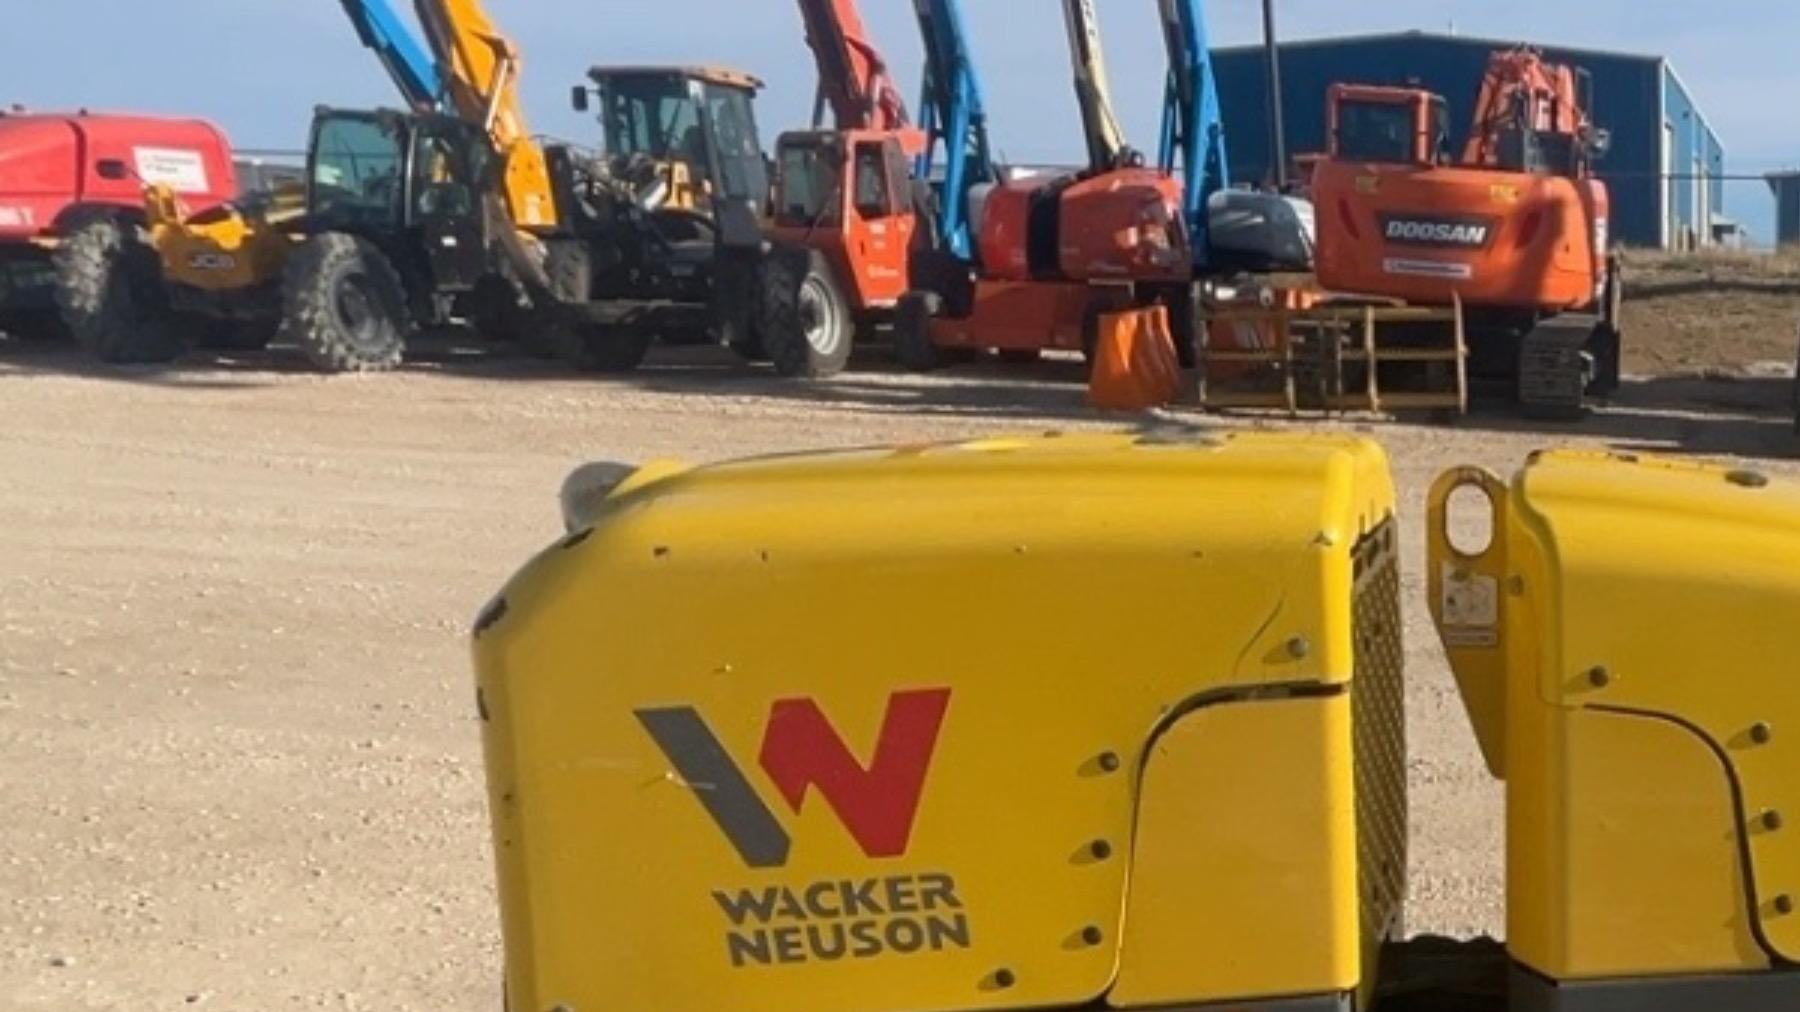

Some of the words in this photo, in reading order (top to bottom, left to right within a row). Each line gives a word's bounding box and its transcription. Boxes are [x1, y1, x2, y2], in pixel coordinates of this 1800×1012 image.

[1386, 220, 1486, 243] DOOSAN
[711, 872, 963, 926] WACKER
[726, 913, 971, 968] NEUSON
